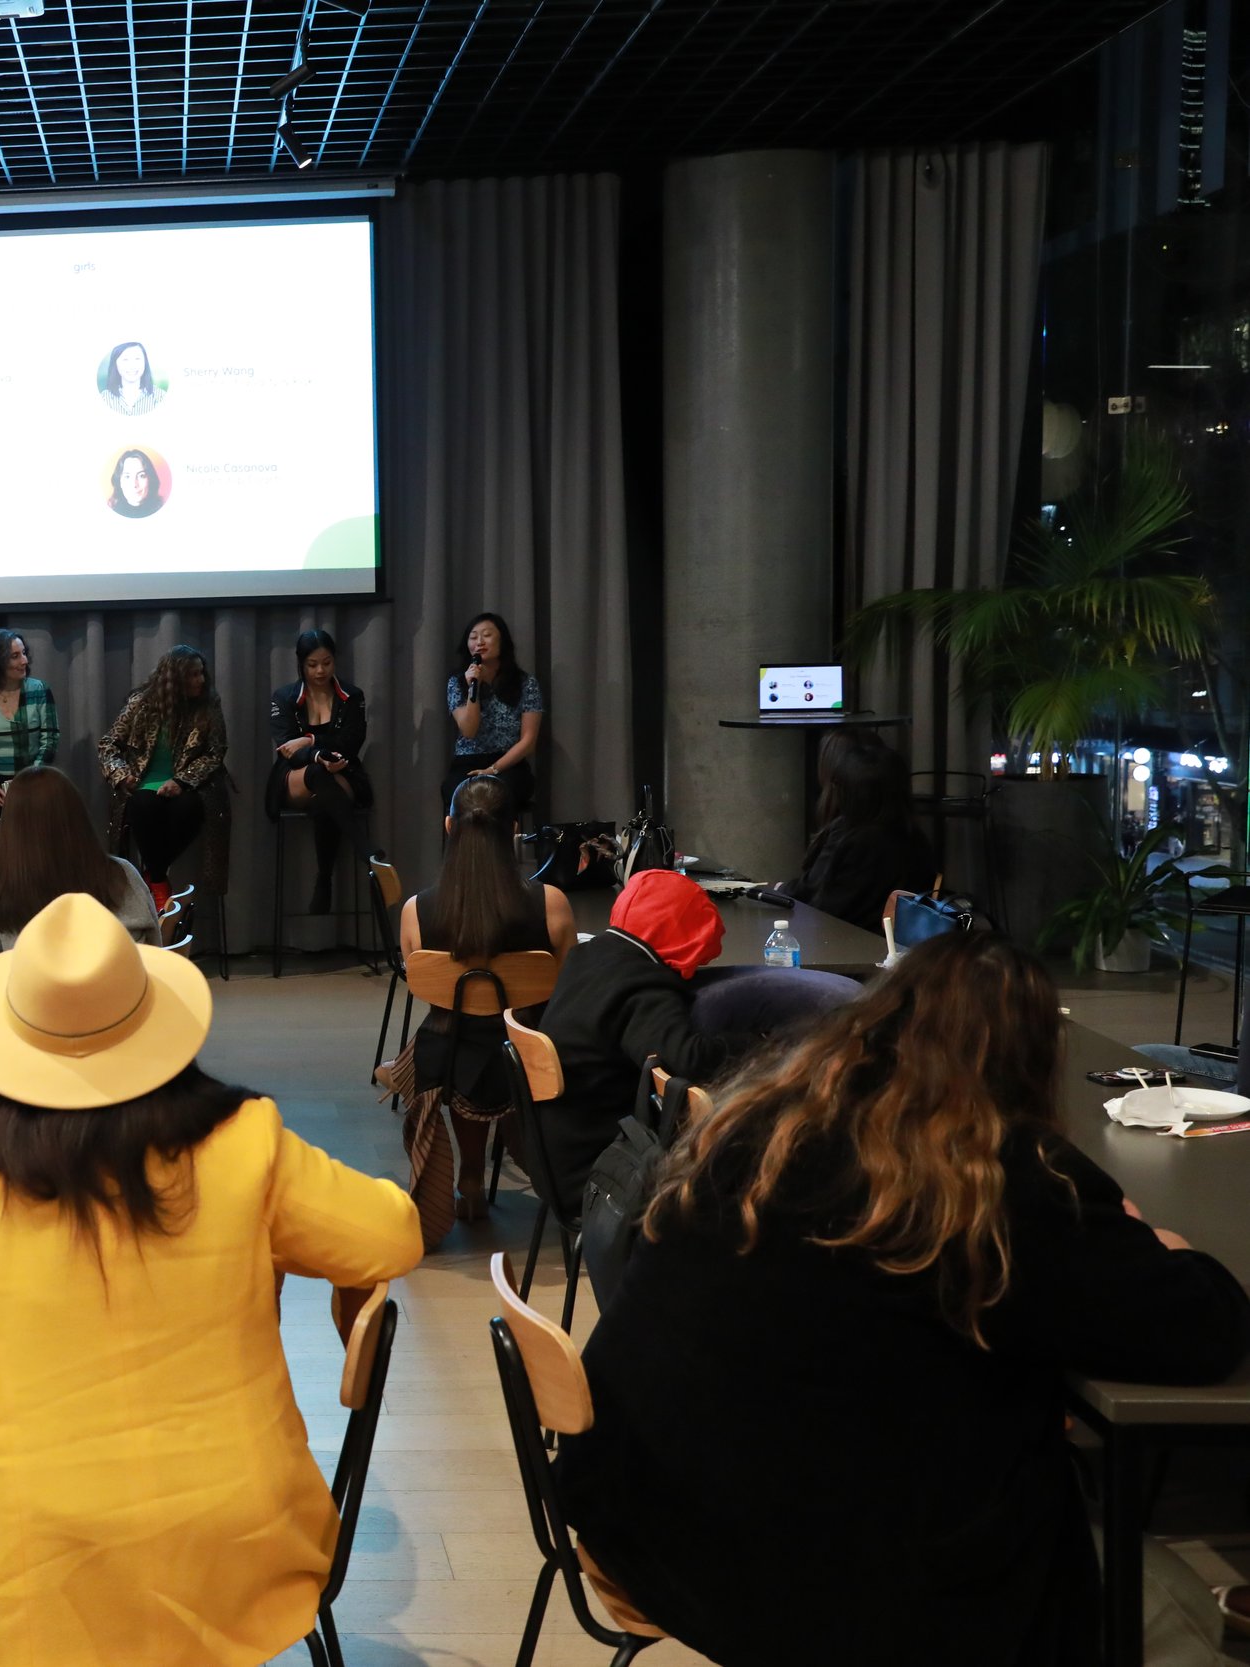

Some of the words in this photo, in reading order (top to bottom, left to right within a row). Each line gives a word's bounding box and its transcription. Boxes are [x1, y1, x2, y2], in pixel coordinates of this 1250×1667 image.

[73, 261, 95, 274] girls
[183, 367, 219, 378] Sherry
[222, 366, 255, 378] Wang
[186, 463, 220, 474] Nicole
[223, 463, 278, 473] Casanova
